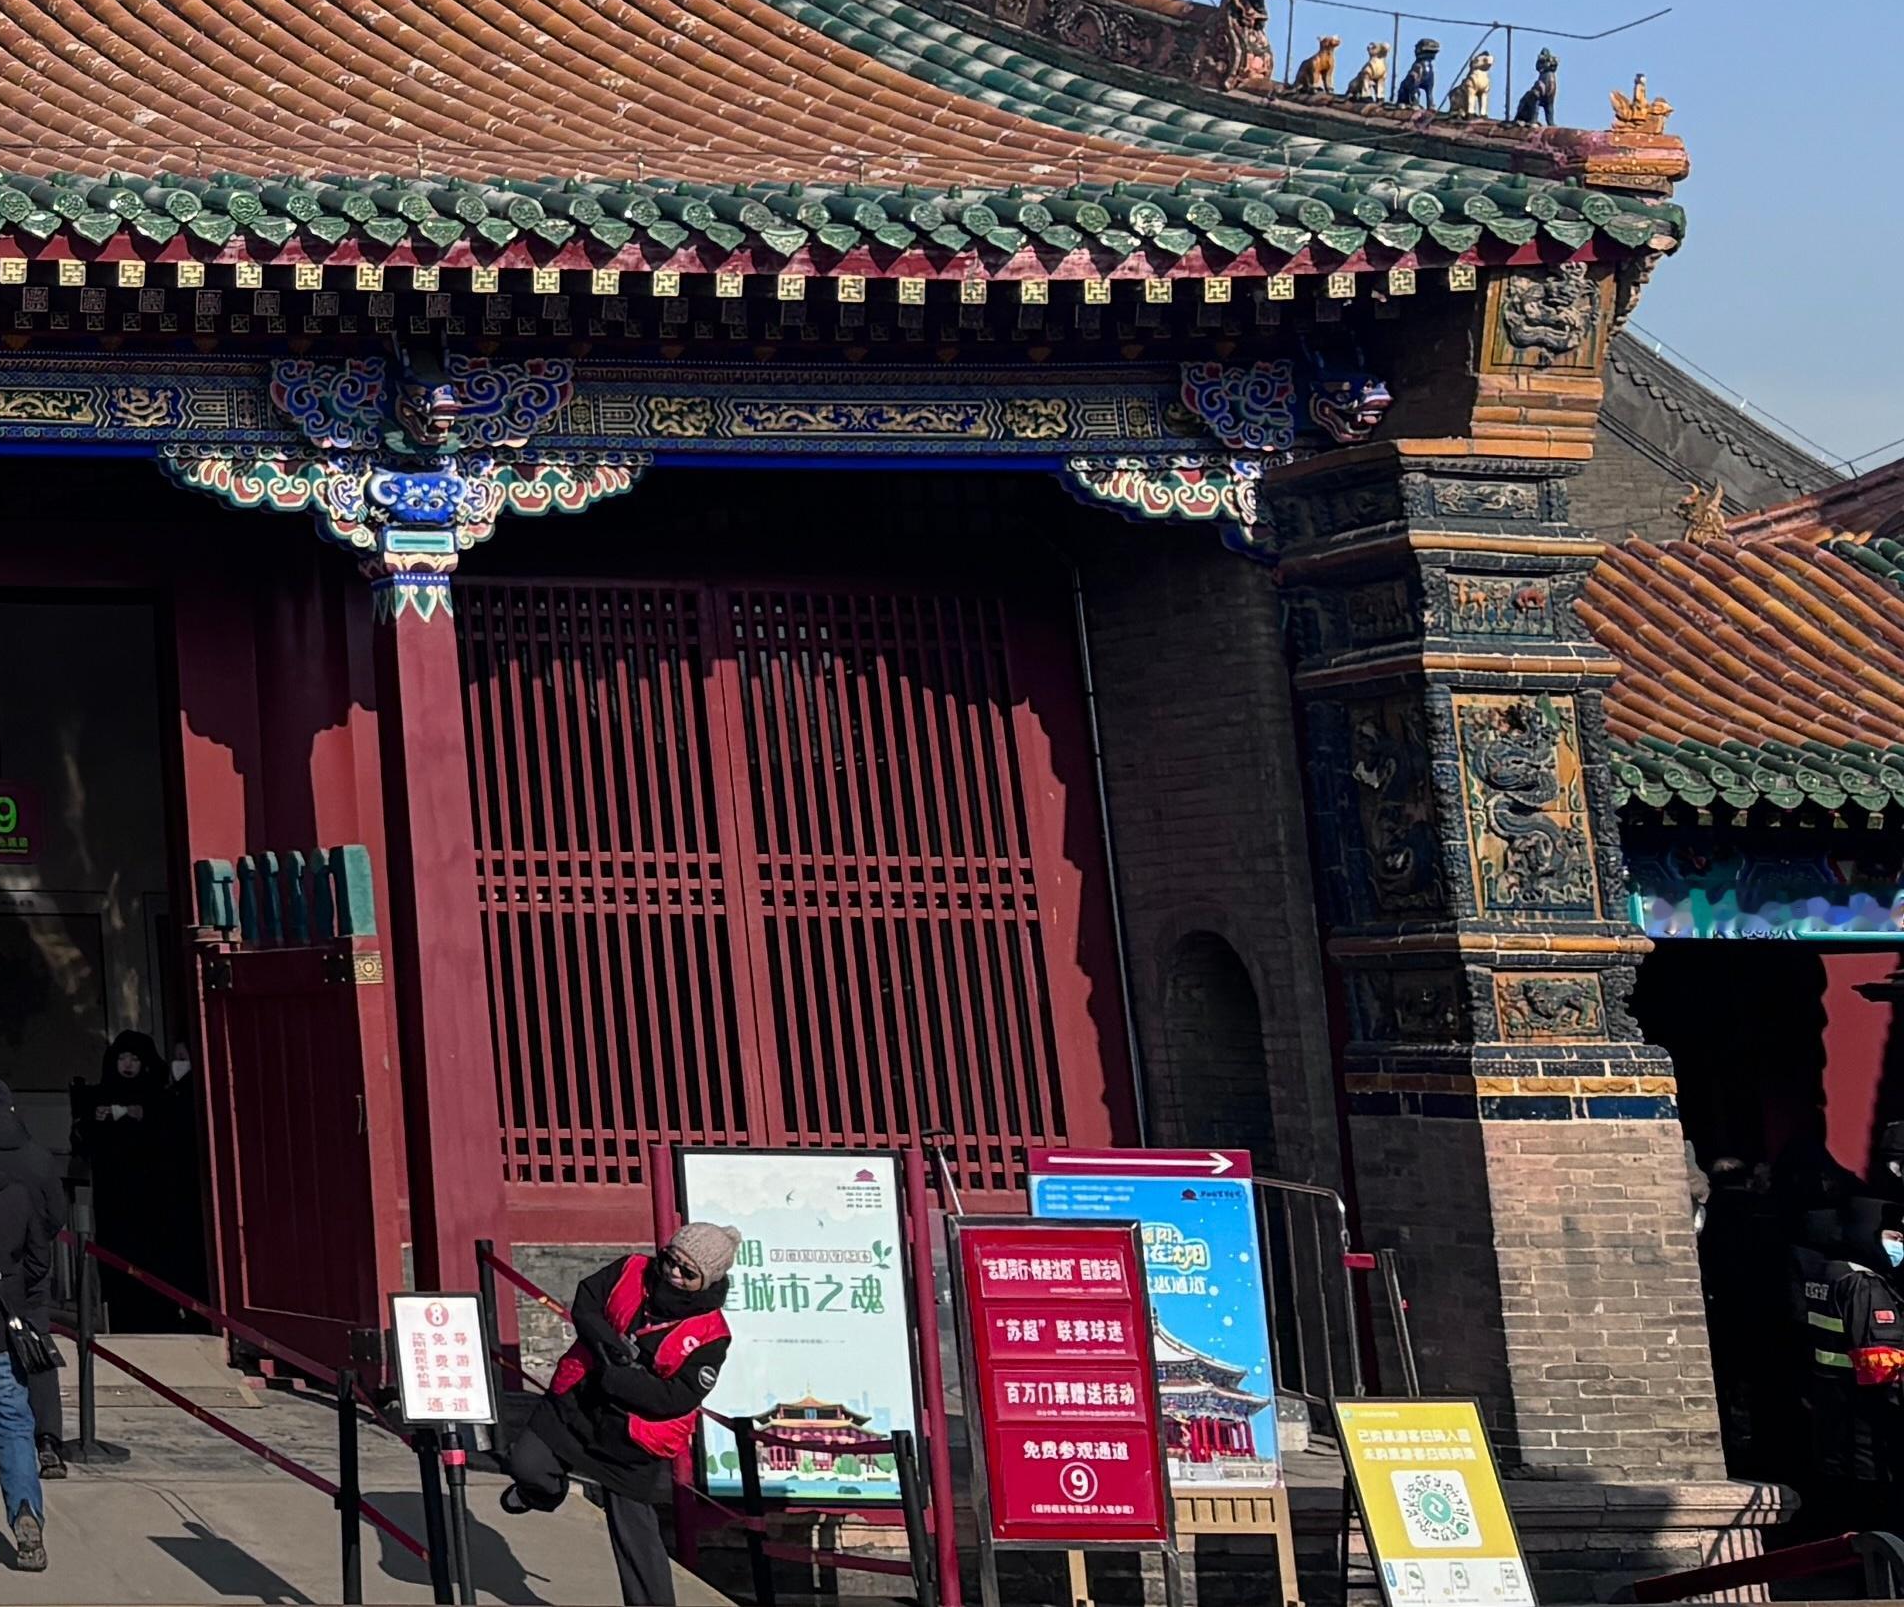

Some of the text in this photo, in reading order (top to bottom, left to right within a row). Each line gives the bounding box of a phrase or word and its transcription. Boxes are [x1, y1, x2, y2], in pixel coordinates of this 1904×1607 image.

[1142, 1244, 1207, 1270] 在沈阳
[1004, 1381, 1135, 1405] 百万门票赠送活动
[1023, 1440, 1129, 1460] 免费参观通道
